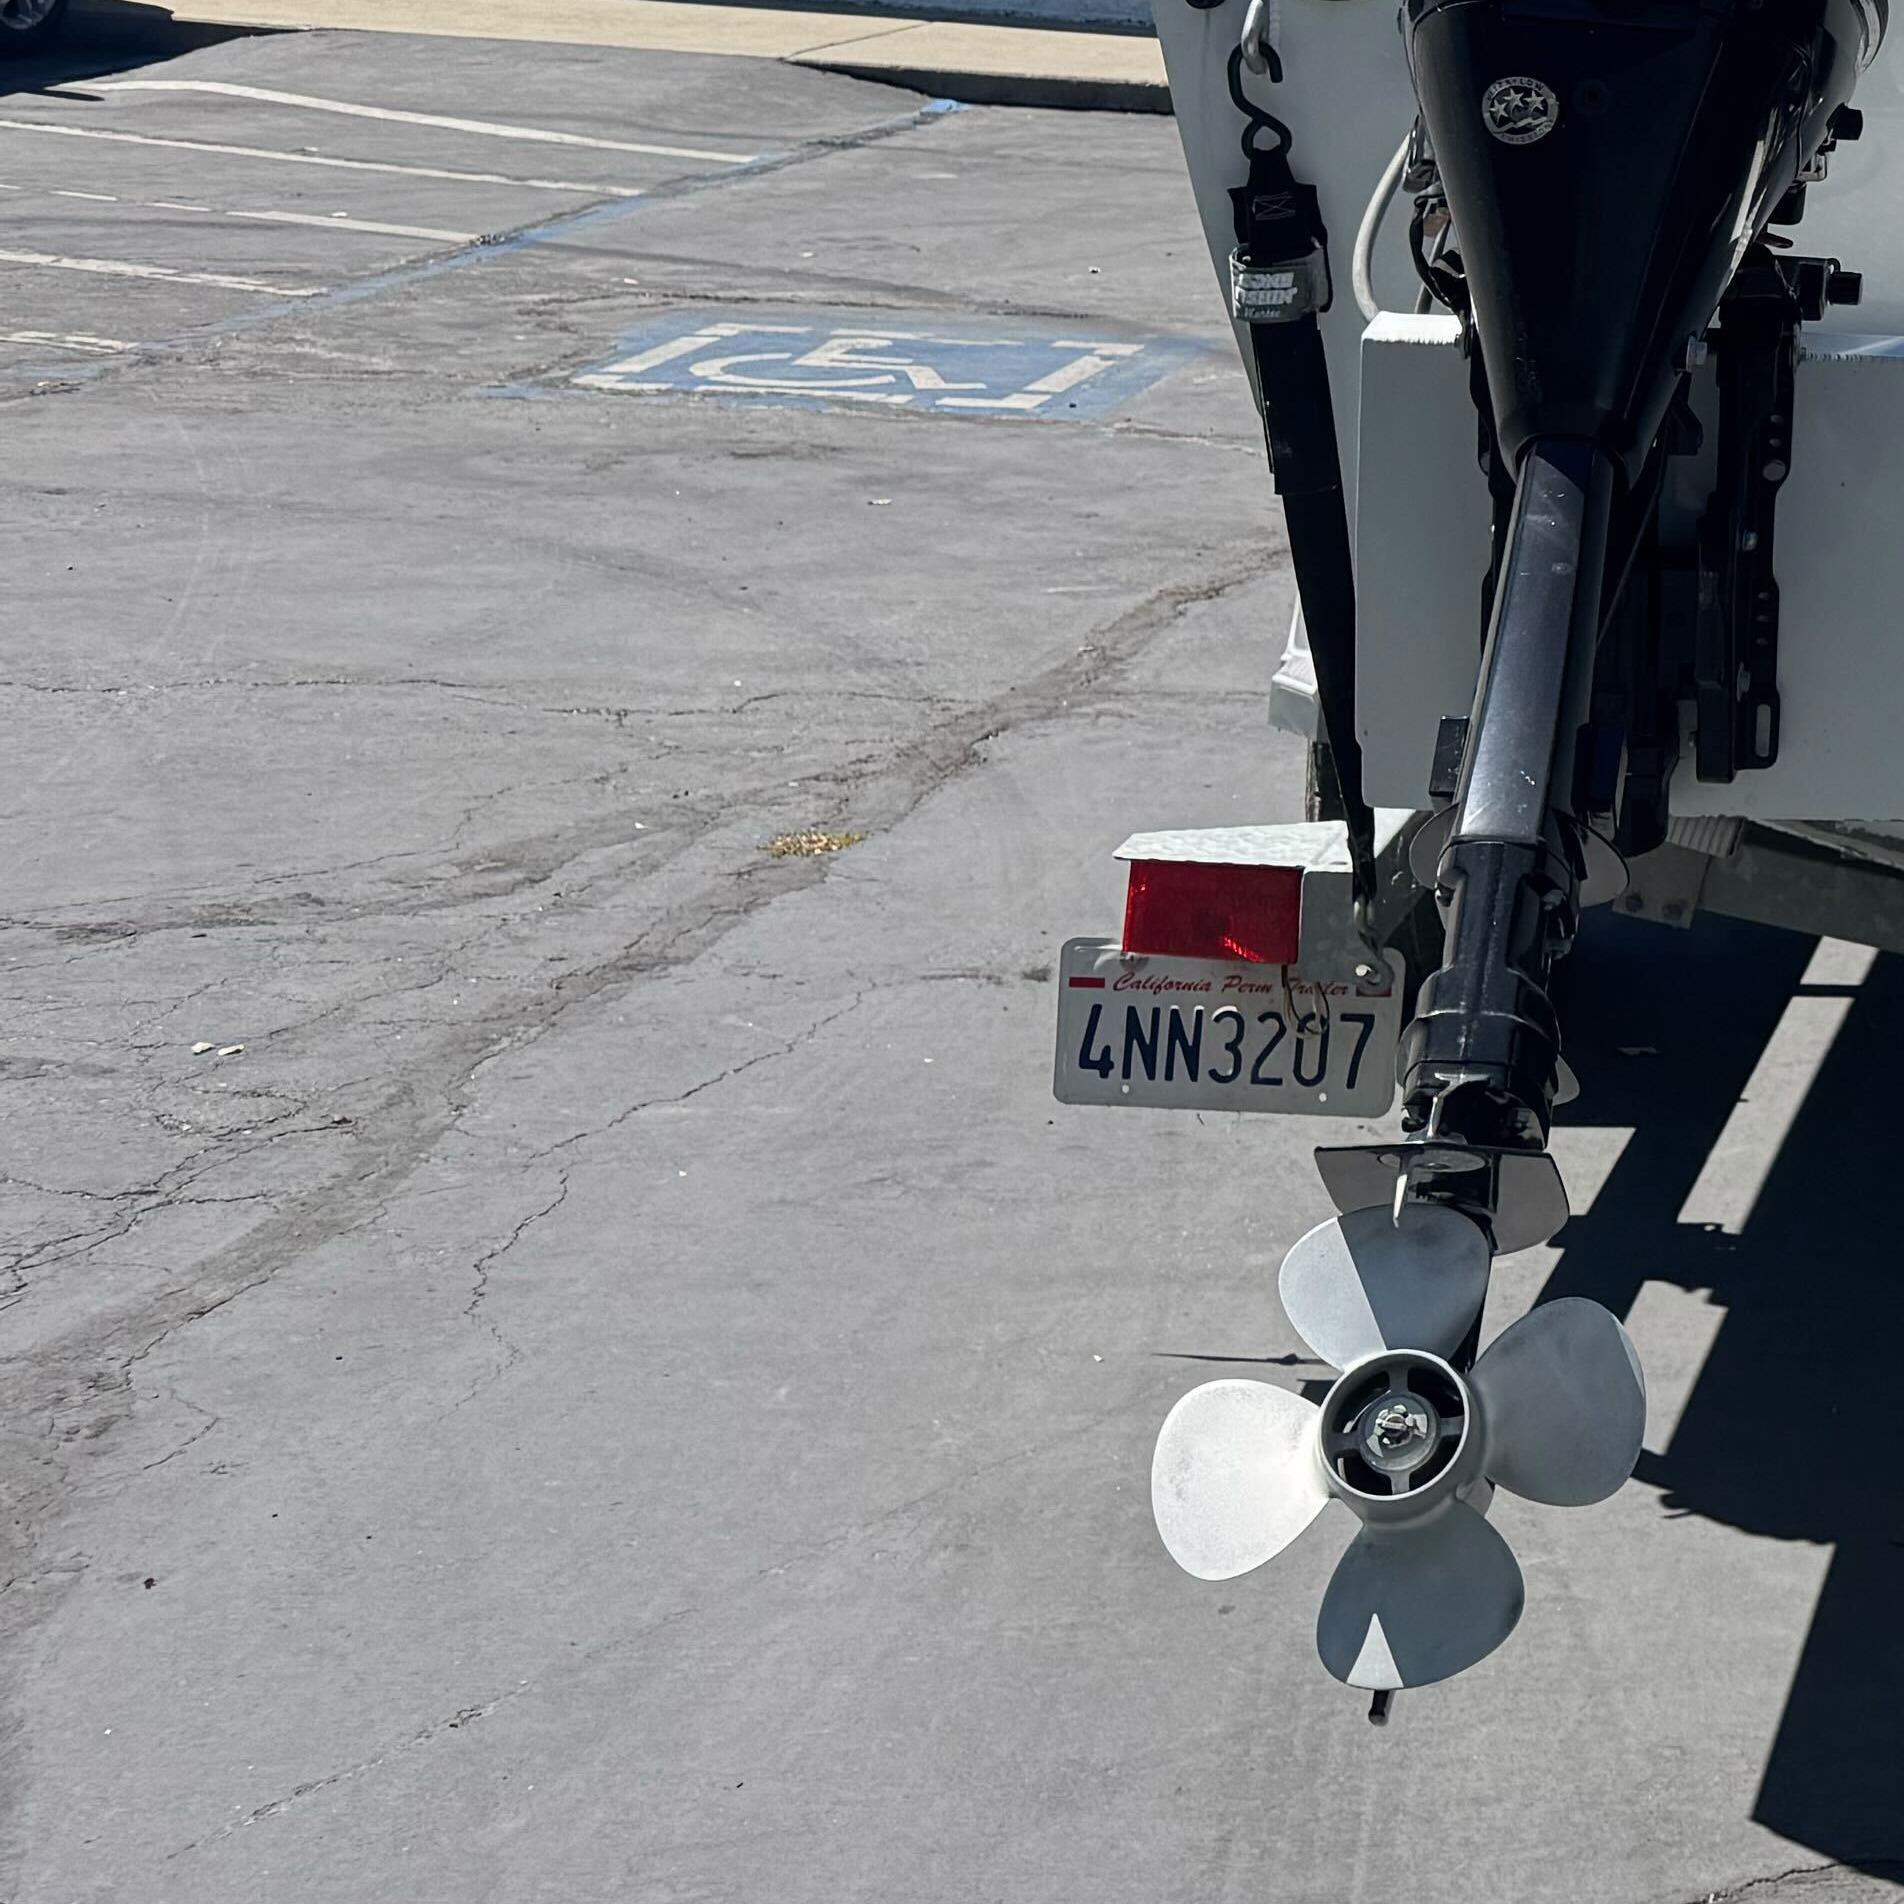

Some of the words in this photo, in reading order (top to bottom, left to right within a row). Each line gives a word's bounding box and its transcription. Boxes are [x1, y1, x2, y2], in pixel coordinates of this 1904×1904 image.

[1113, 971, 1213, 995] California
[1221, 975, 1273, 994] Perm
[1078, 1003, 1376, 1091] 4NN3207
